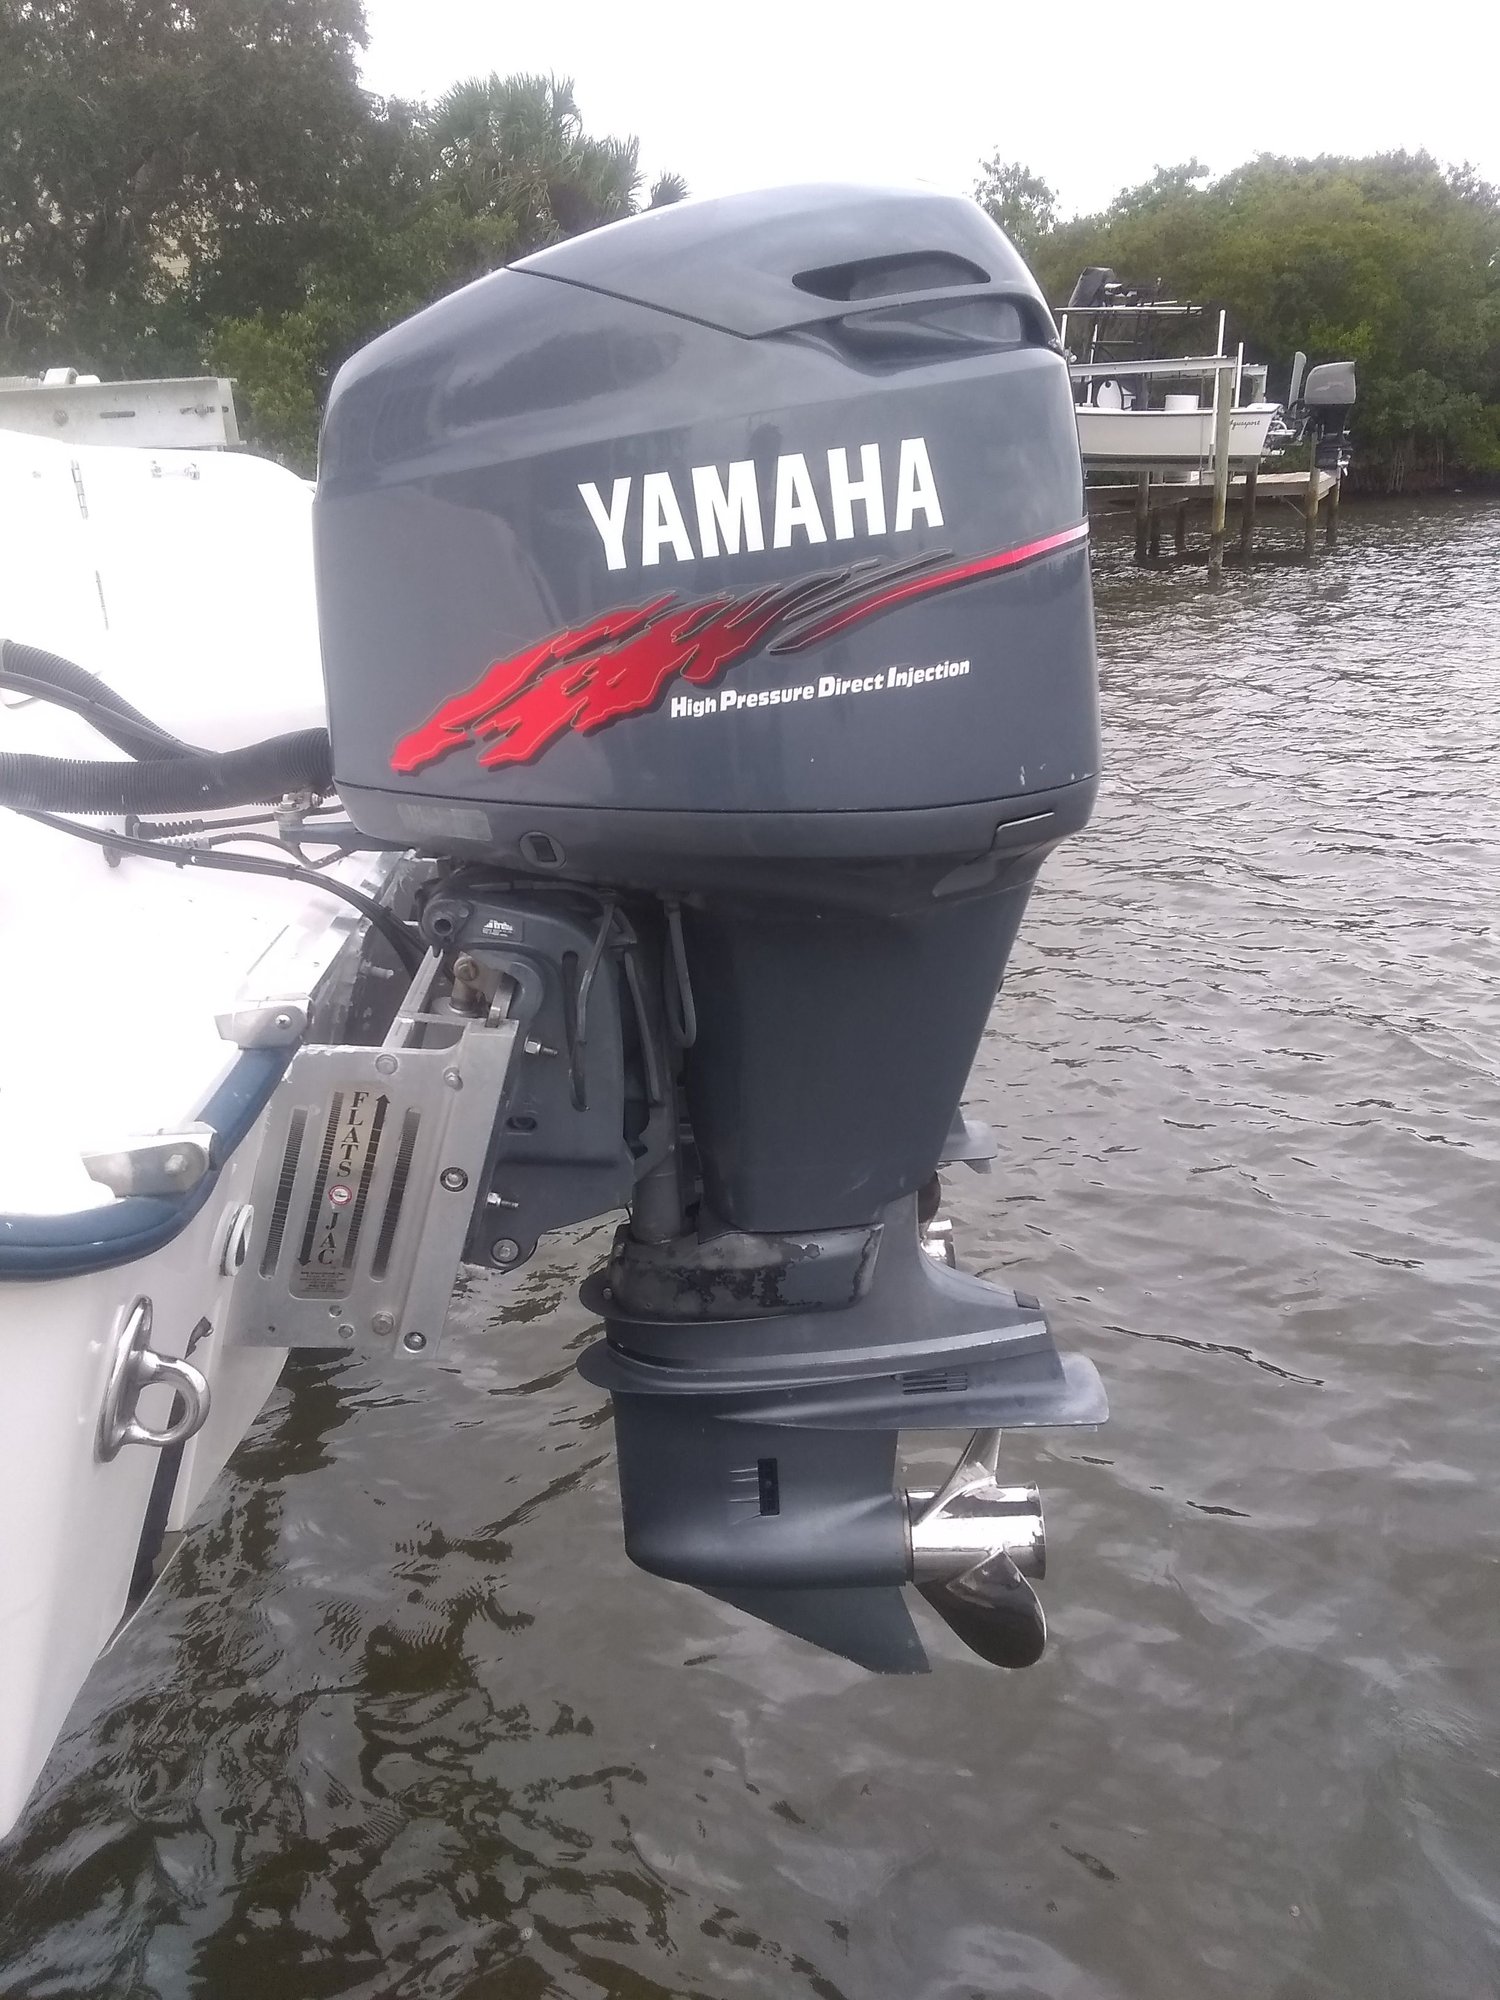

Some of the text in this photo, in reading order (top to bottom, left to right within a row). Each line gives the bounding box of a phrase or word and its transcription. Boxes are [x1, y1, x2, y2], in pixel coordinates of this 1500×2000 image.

[1230, 419, 1260, 430] quasport
[577, 437, 944, 570] YAMAHA
[670, 659, 970, 718] High Pressure Direct Injection
[337, 1091, 369, 1177] FLATS
[318, 1212, 339, 1265] JAC
